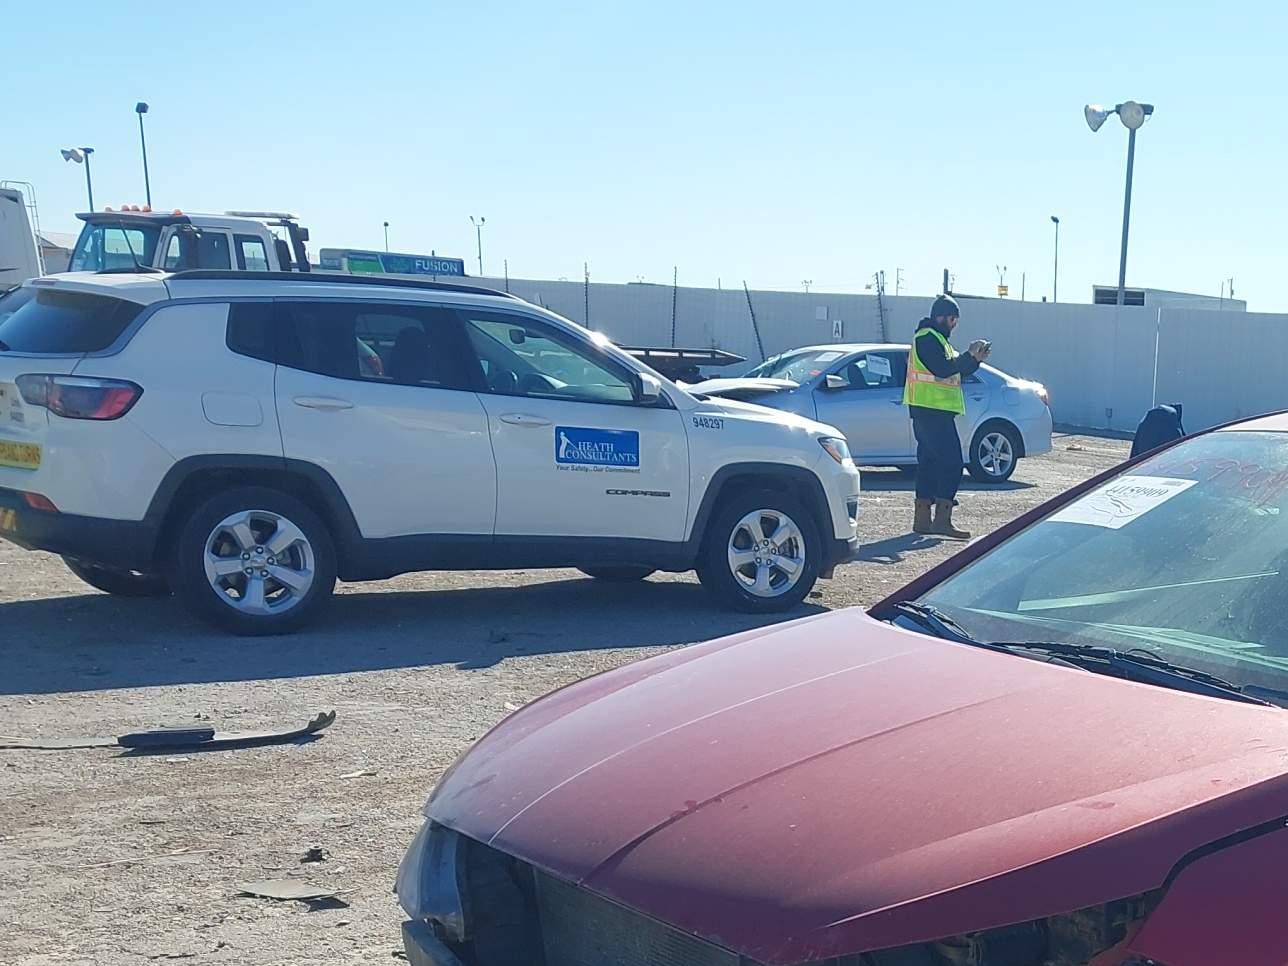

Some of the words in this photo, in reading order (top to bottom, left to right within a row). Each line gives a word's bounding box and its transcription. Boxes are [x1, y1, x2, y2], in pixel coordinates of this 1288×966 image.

[416, 260, 458, 272] FUSION
[834, 322, 840, 336] A
[693, 417, 724, 430] 948297
[578, 441, 614, 452] HEATH
[566, 450, 637, 462] CONSULTANTS
[606, 488, 671, 497] COMPASS
